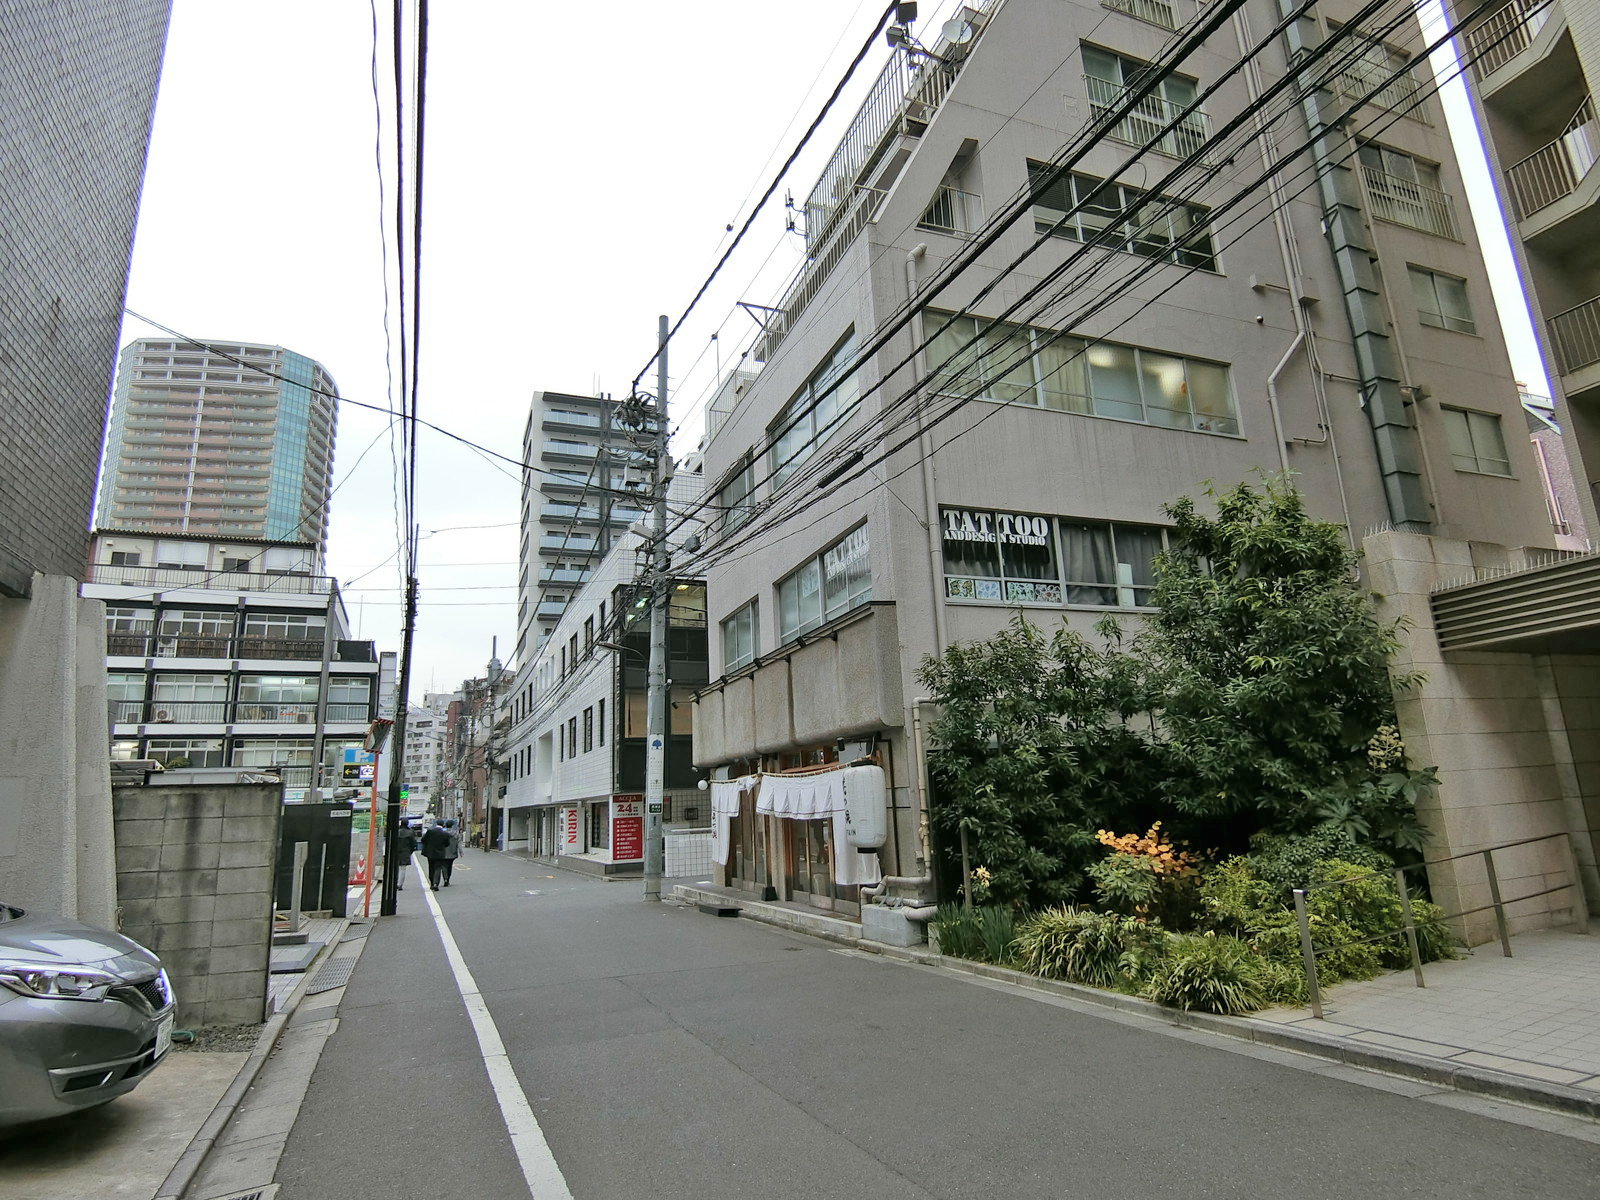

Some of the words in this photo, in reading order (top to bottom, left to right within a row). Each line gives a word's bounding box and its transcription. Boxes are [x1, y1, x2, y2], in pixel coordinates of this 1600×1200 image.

[943, 510, 1048, 537] TATTOO
[1009, 534, 1046, 546] STUDIO
[355, 750, 369, 762] P
[617, 803, 632, 813] 24
[567, 809, 577, 844] KIRIN
